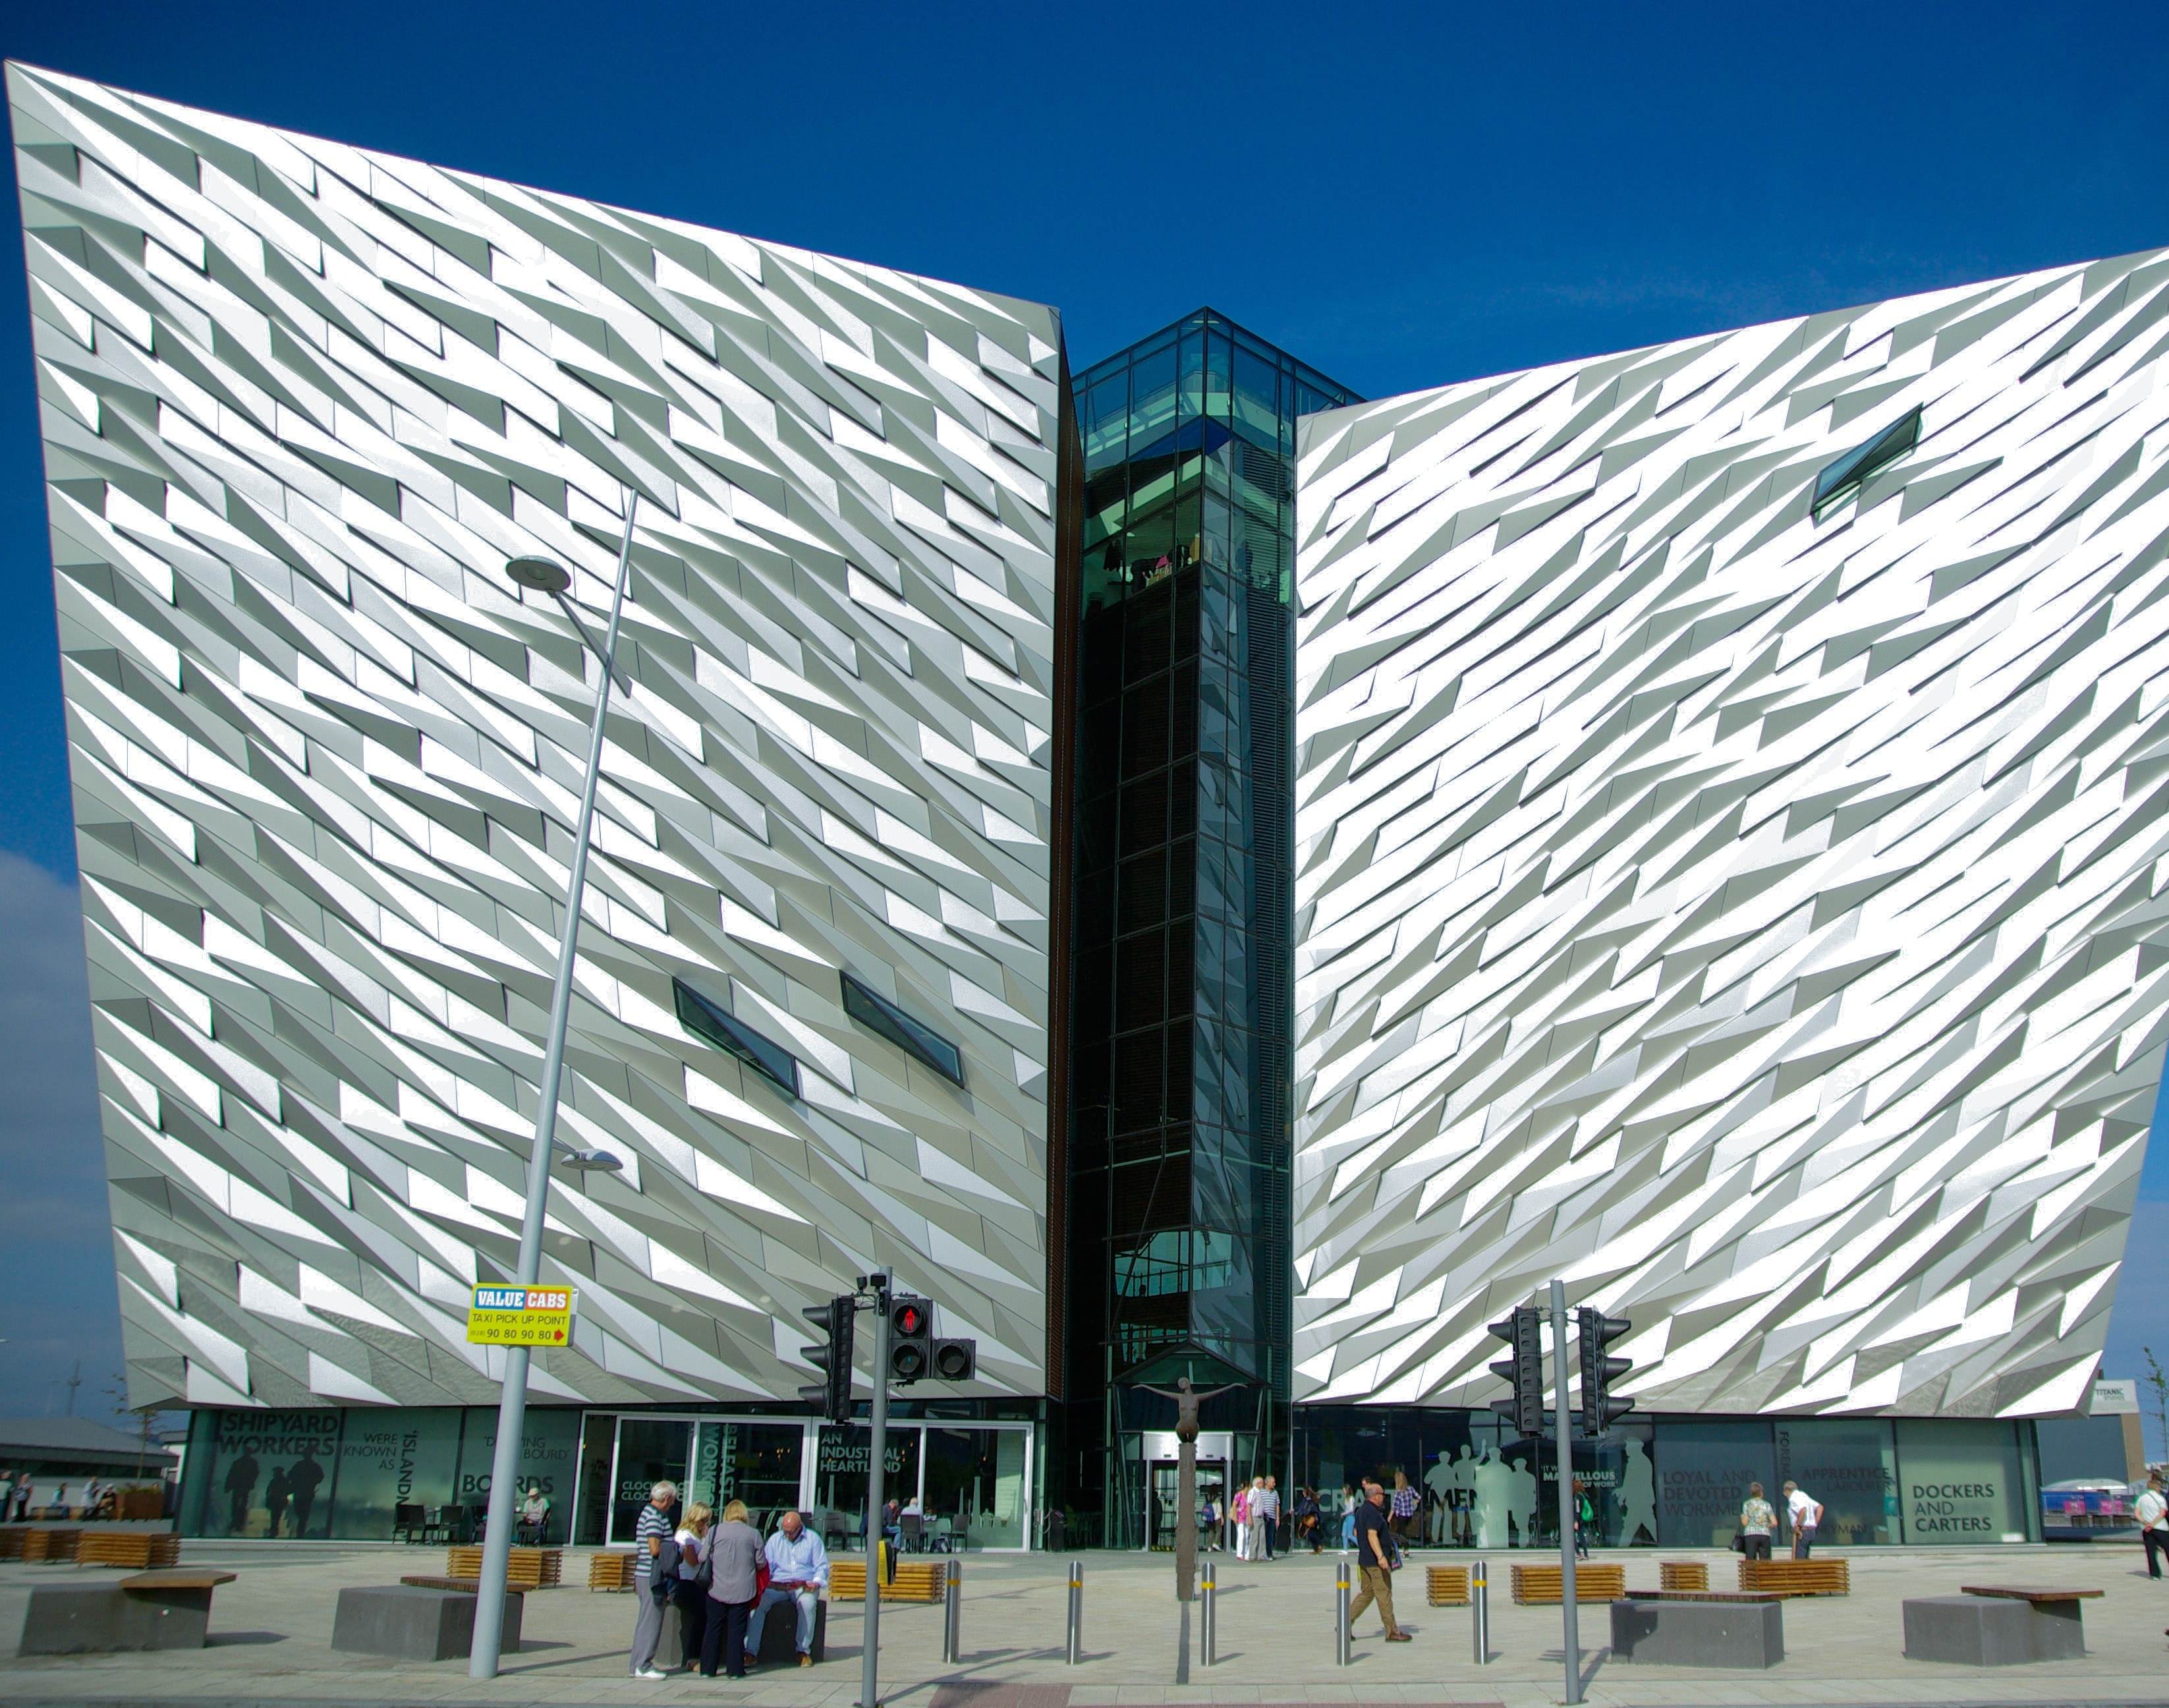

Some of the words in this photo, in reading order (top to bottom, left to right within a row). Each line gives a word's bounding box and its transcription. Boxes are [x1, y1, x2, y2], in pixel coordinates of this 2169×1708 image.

[477, 1290, 524, 1307] VALUE
[527, 1292, 567, 1309] CABS
[472, 1313, 493, 1323] TAXI
[496, 1314, 518, 1323] PICK
[522, 1315, 534, 1324] UP
[538, 1316, 567, 1326] POINT
[487, 1328, 499, 1338] 90
[503, 1329, 517, 1338] 80
[521, 1330, 534, 1339] 90
[538, 1330, 551, 1340] 80
[224, 1413, 339, 1434] SHIPYARD
[219, 1435, 336, 1456] WORKERS
[364, 1433, 398, 1444] WERE
[820, 1433, 842, 1445] AN
[343, 1446, 397, 1458] KNOWN
[820, 1446, 900, 1460] INDUSTAL
[378, 1460, 395, 1470] AS
[718, 1425, 738, 1499] BELFAST
[820, 1460, 901, 1473] HEARTLND
[1543, 1471, 1616, 1482] MAELLOUS
[1663, 1471, 1714, 1485] LOYAL
[1721, 1469, 1757, 1484] AND
[1802, 1467, 1890, 1480] APPRENTICE
[463, 1474, 554, 1494] BORDS
[1664, 1487, 1742, 1500] DEVOTED
[1913, 1484, 1995, 1500] DOCKERS
[1664, 1502, 1741, 1517] WORKME
[1915, 1502, 1954, 1516] AND
[1915, 1517, 1992, 1533] CARTERS
